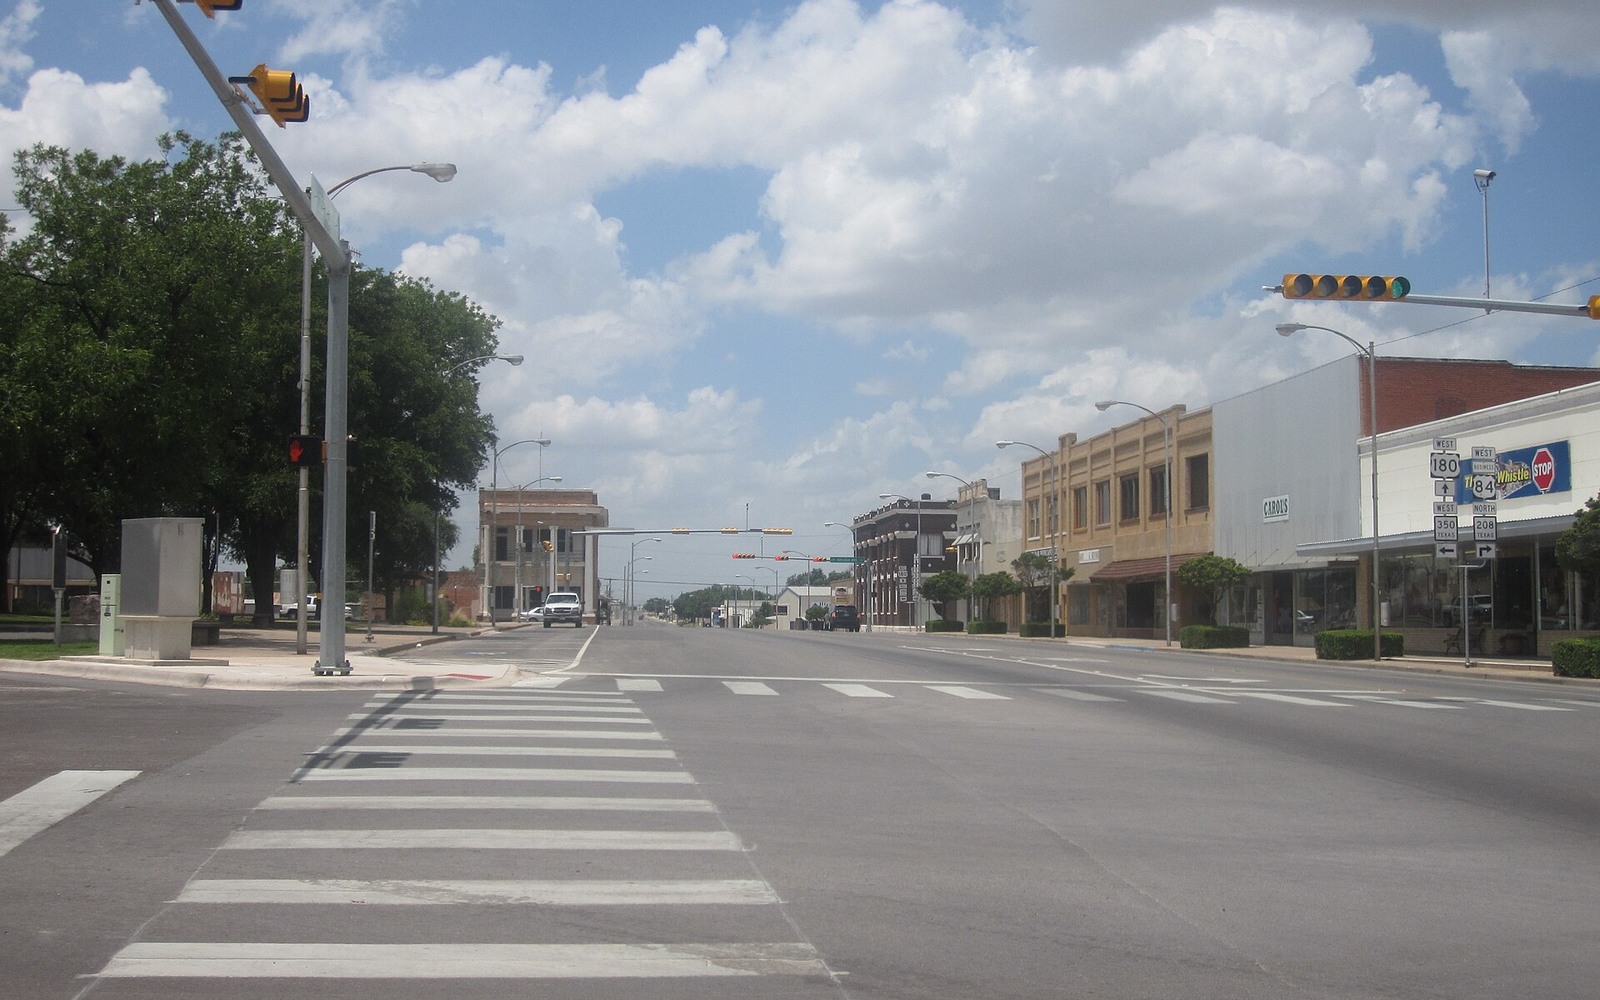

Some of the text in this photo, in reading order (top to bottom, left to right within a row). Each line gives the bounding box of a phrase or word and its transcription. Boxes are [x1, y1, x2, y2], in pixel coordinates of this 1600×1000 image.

[1436, 440, 1454, 448] WEST
[1475, 449, 1492, 457] WEST
[1433, 458, 1458, 472] 180
[1497, 462, 1552, 484] Whistle STOP
[1475, 480, 1494, 493] 84
[1436, 504, 1454, 512] WEST
[1474, 504, 1495, 512] NORTH
[1437, 520, 1455, 529] 350
[1476, 520, 1494, 529] 208
